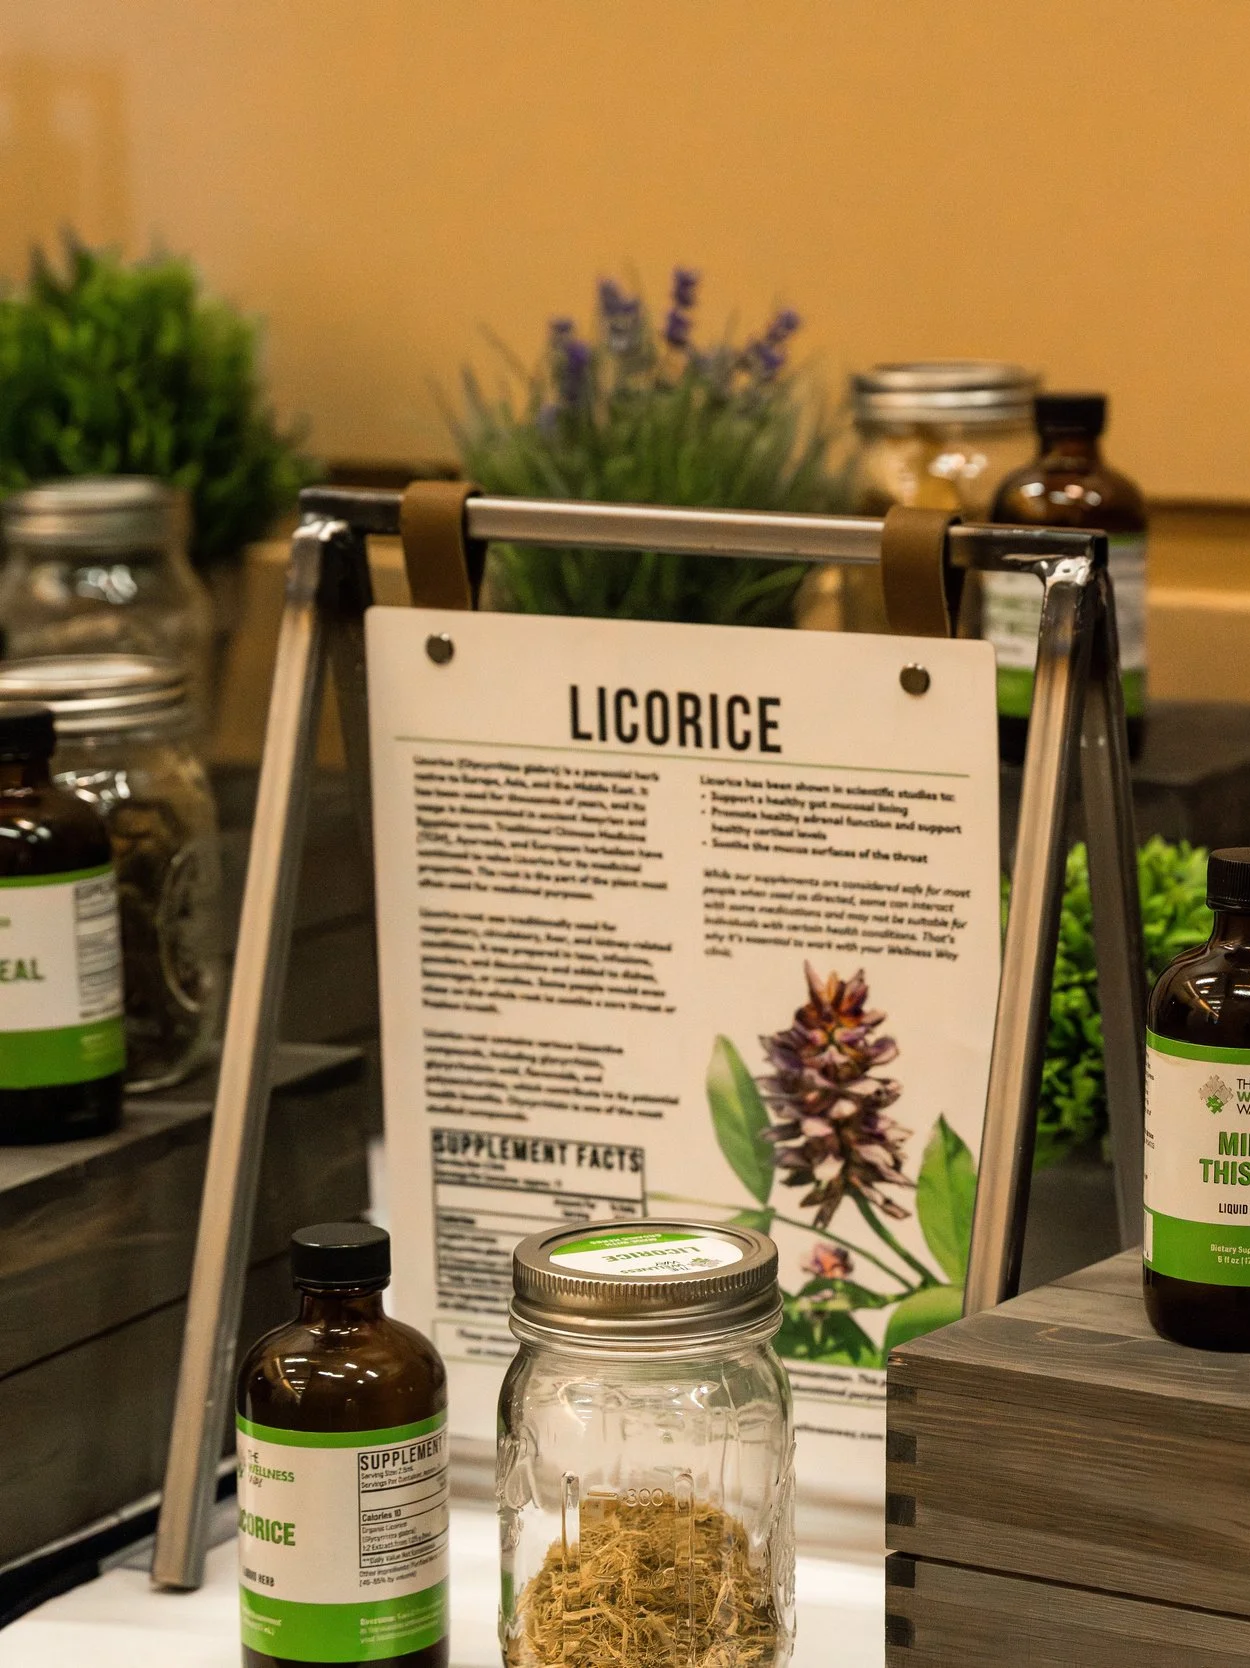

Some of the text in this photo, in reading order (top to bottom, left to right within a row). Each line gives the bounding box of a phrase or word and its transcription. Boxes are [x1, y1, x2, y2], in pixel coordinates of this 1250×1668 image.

[569, 684, 783, 753] LICORICE
[700, 774, 740, 786] Licorice
[746, 778, 762, 788] has
[767, 779, 790, 790] been
[796, 782, 829, 793] shown
[833, 784, 841, 794] in
[846, 786, 893, 798] scientific
[898, 790, 936, 802] studies
[711, 792, 754, 806] Support
[766, 796, 804, 810] healthy
[808, 799, 826, 812] gut
[761, 811, 799, 825] healthy
[803, 814, 842, 827] adrenal
[846, 818, 891, 830] function
[895, 821, 913, 832] and
[918, 824, 961, 838] support
[859, 850, 869, 860] of
[872, 851, 889, 861] the
[893, 853, 927, 864] throat
[924, 887, 940, 897] for
[943, 888, 970, 899] most
[951, 920, 967, 931] for
[433, 1130, 641, 1174] SUPPLEMENT FACTS
[1218, 1203, 1248, 1215] LIQUID
[601, 1246, 701, 1263] LICORICE
[1210, 1244, 1236, 1255] Dietary
[360, 1436, 442, 1470] SUPPLEMENT
[361, 1479, 387, 1489] Servings
[362, 1511, 392, 1522] Calories
